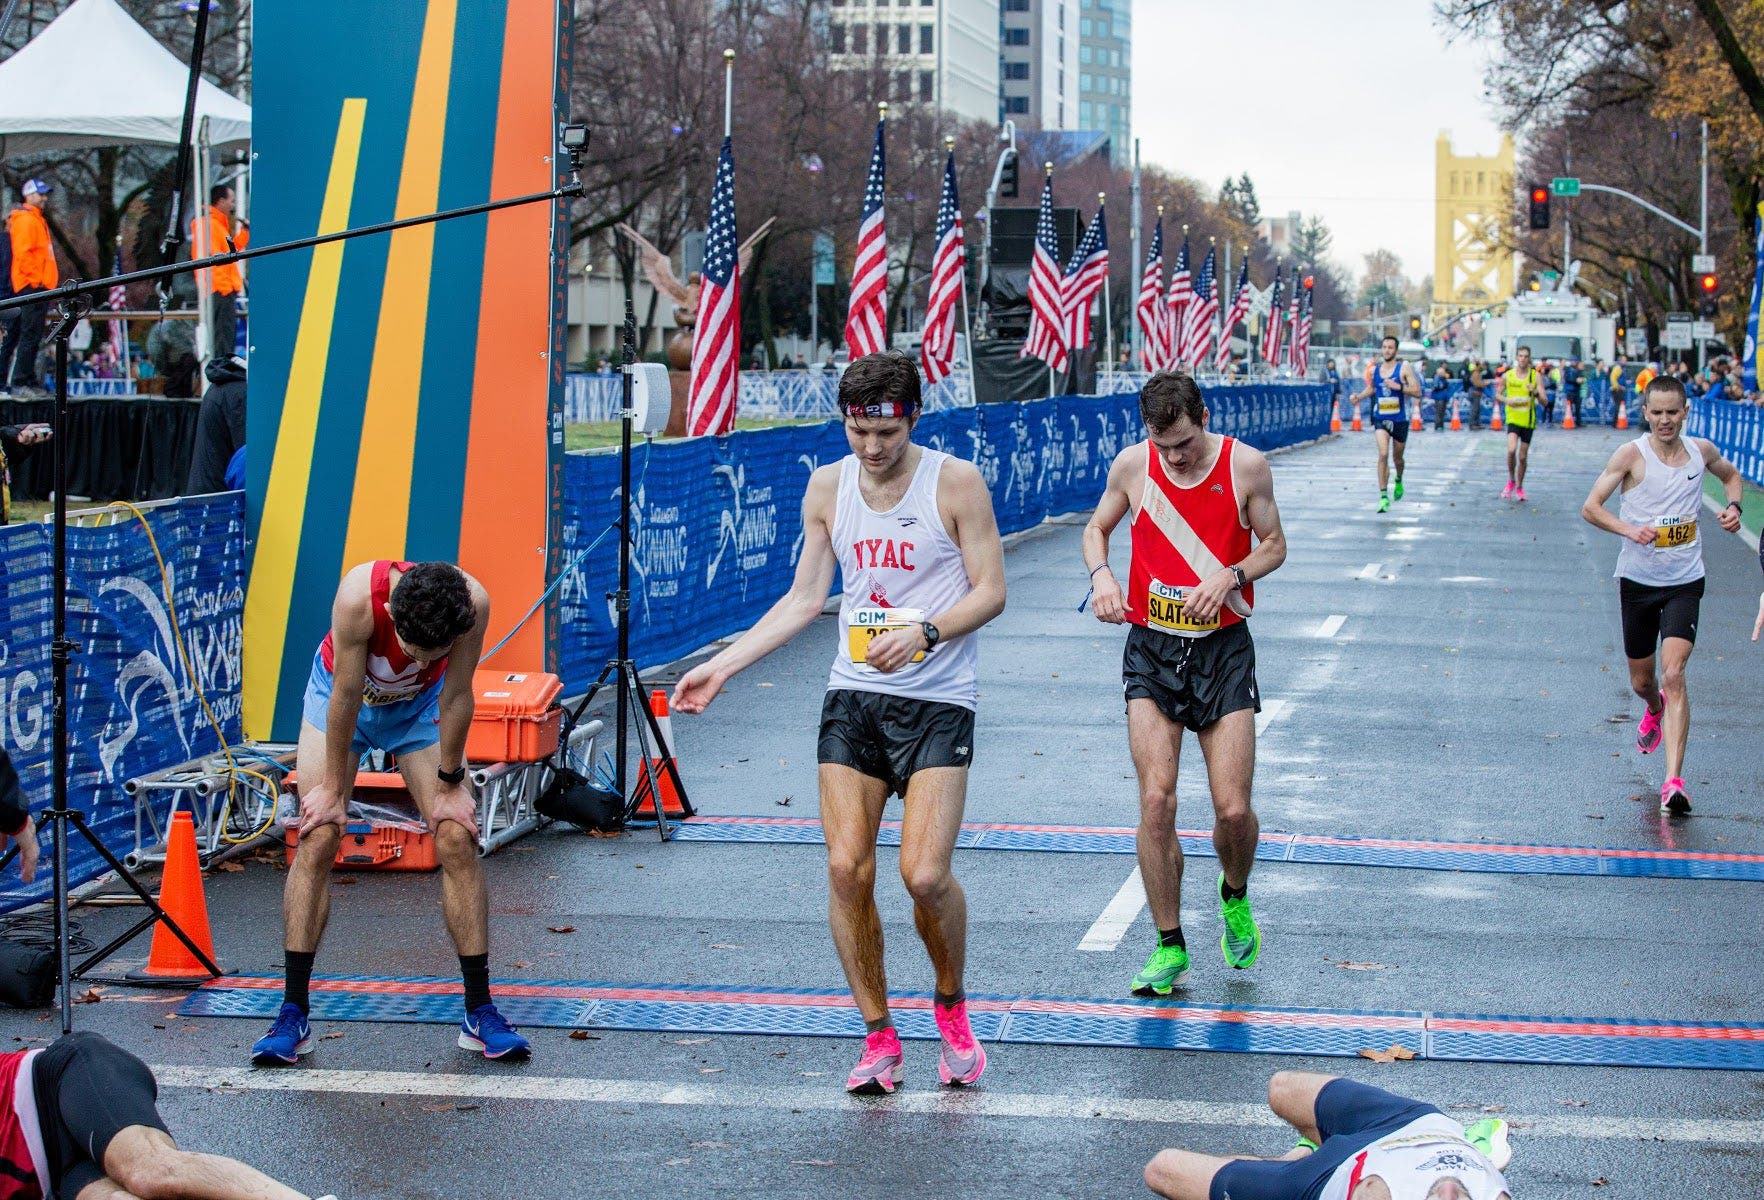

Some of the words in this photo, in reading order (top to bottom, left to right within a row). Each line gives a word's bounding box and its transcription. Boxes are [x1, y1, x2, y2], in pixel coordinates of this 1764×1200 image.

[1662, 517, 1680, 526] CIM
[1668, 525, 1689, 541] 462
[853, 538, 916, 572] NYAC
[1160, 585, 1182, 600] CIM
[858, 611, 886, 624] CIM
[1149, 597, 1219, 626] SLATY
